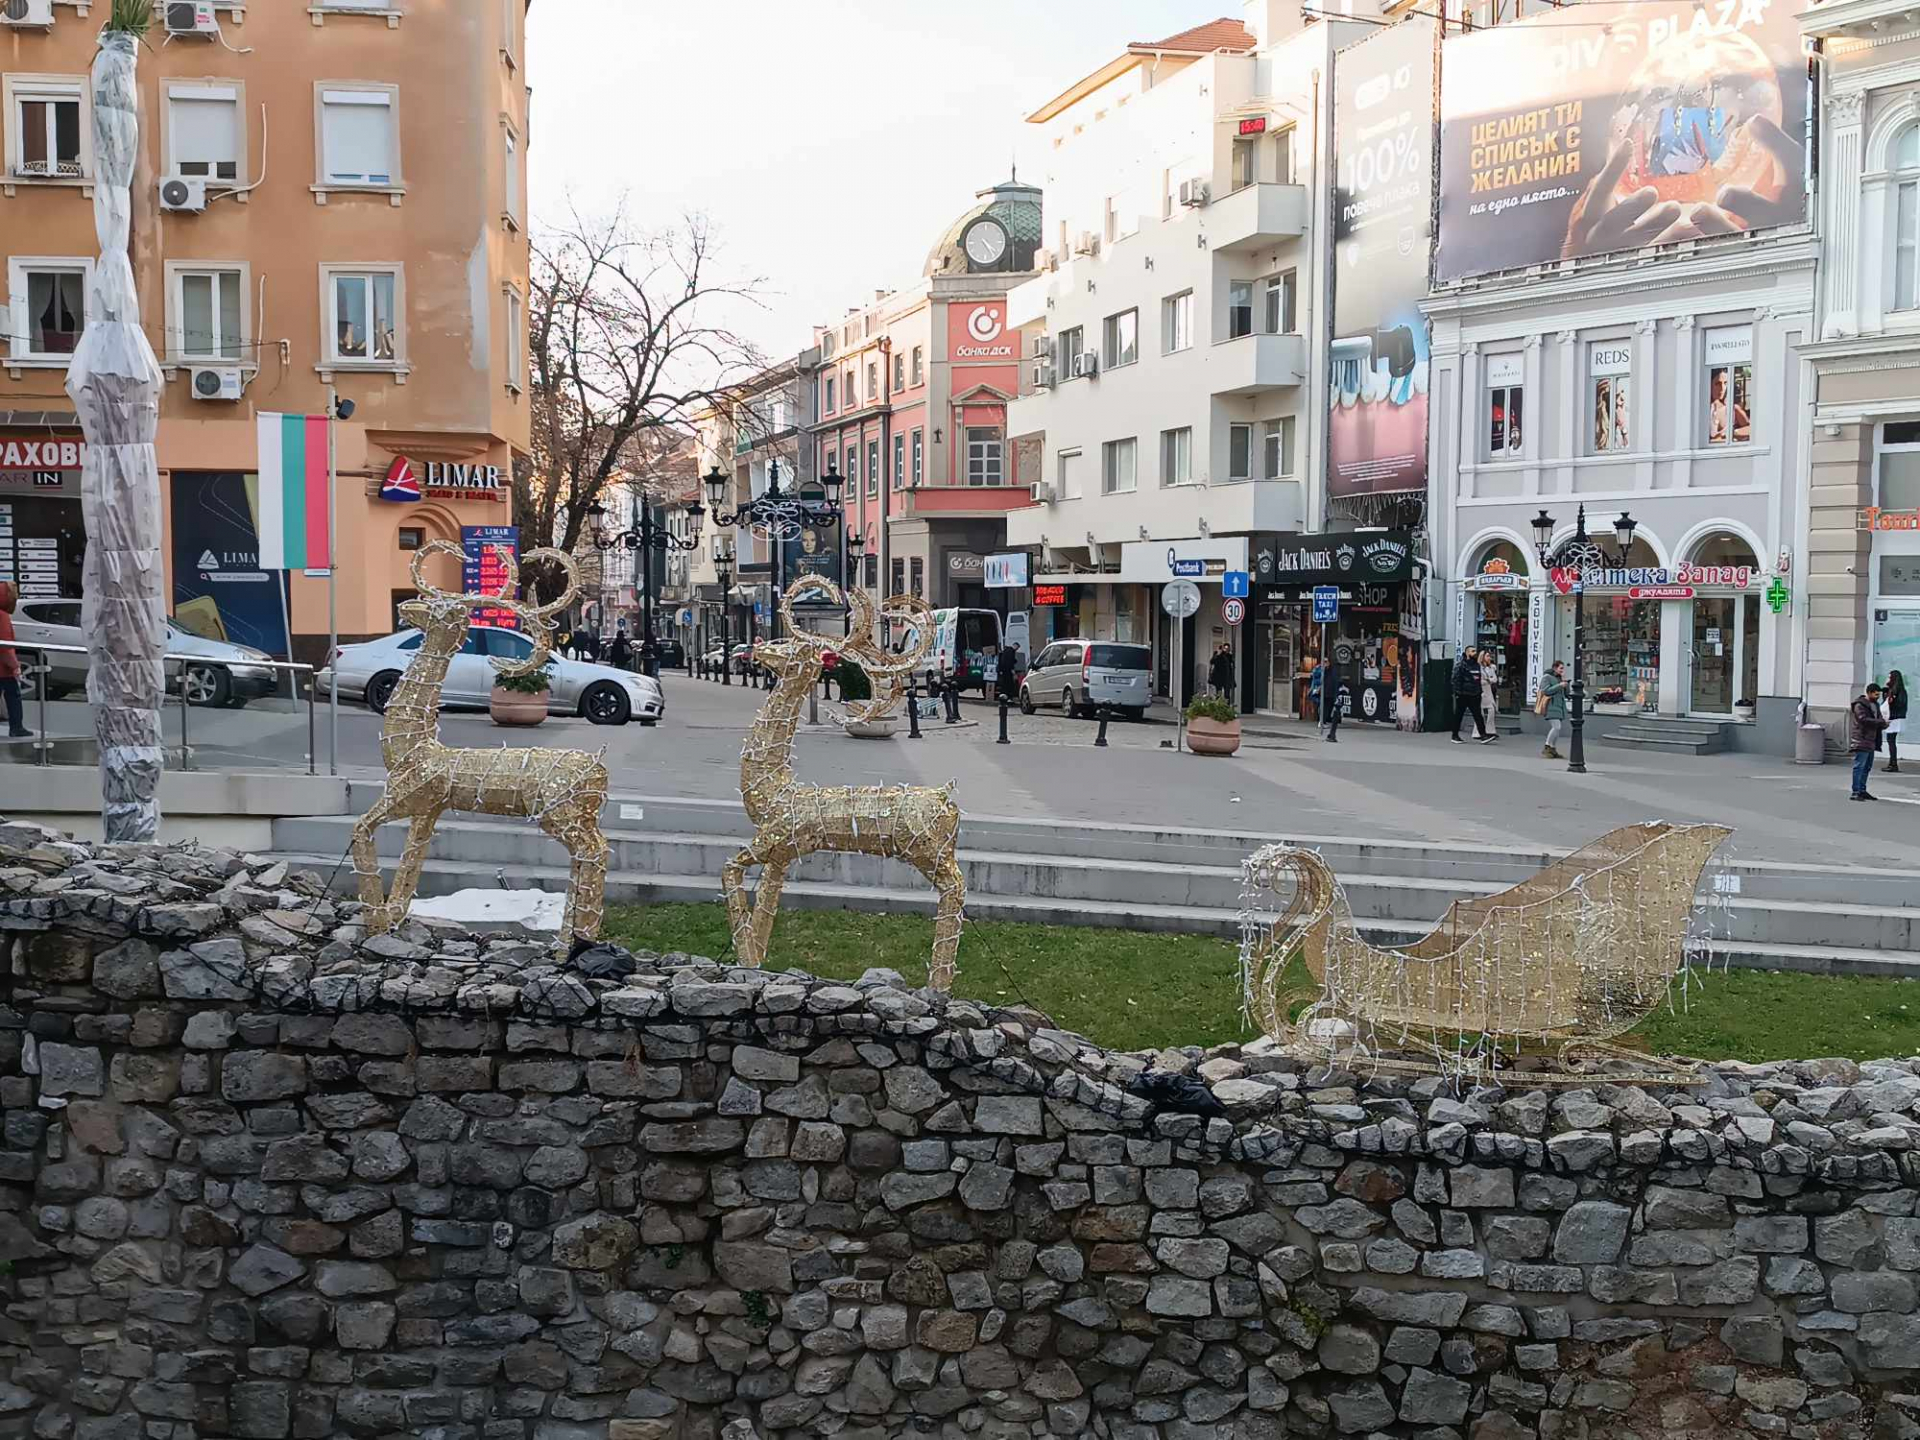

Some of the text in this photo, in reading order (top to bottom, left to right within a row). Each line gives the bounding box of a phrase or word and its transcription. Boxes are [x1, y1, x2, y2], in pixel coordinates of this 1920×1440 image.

[1472, 100, 1583, 147] ЦЕЛИЯТ ТИ
[1471, 126, 1580, 169] СПИСЪК С
[1346, 126, 1420, 196] 100%
[1470, 151, 1580, 194] ЖЕЛАНИЯ
[1469, 203, 1487, 215] на
[1488, 197, 1520, 215] едно
[956, 345, 989, 357] банка
[1595, 349, 1630, 365] REDS
[0, 442, 86, 466] АХОВ
[37, 472, 58, 484] IN
[426, 461, 500, 489] LIMAR
[223, 552, 258, 563] LIMA
[964, 557, 984, 568] бан
[1278, 548, 1298, 571] JACK
[1677, 562, 1751, 588] Запад
[1227, 605, 1240, 618] 30
[1531, 596, 1540, 697] SOUVENIRS
